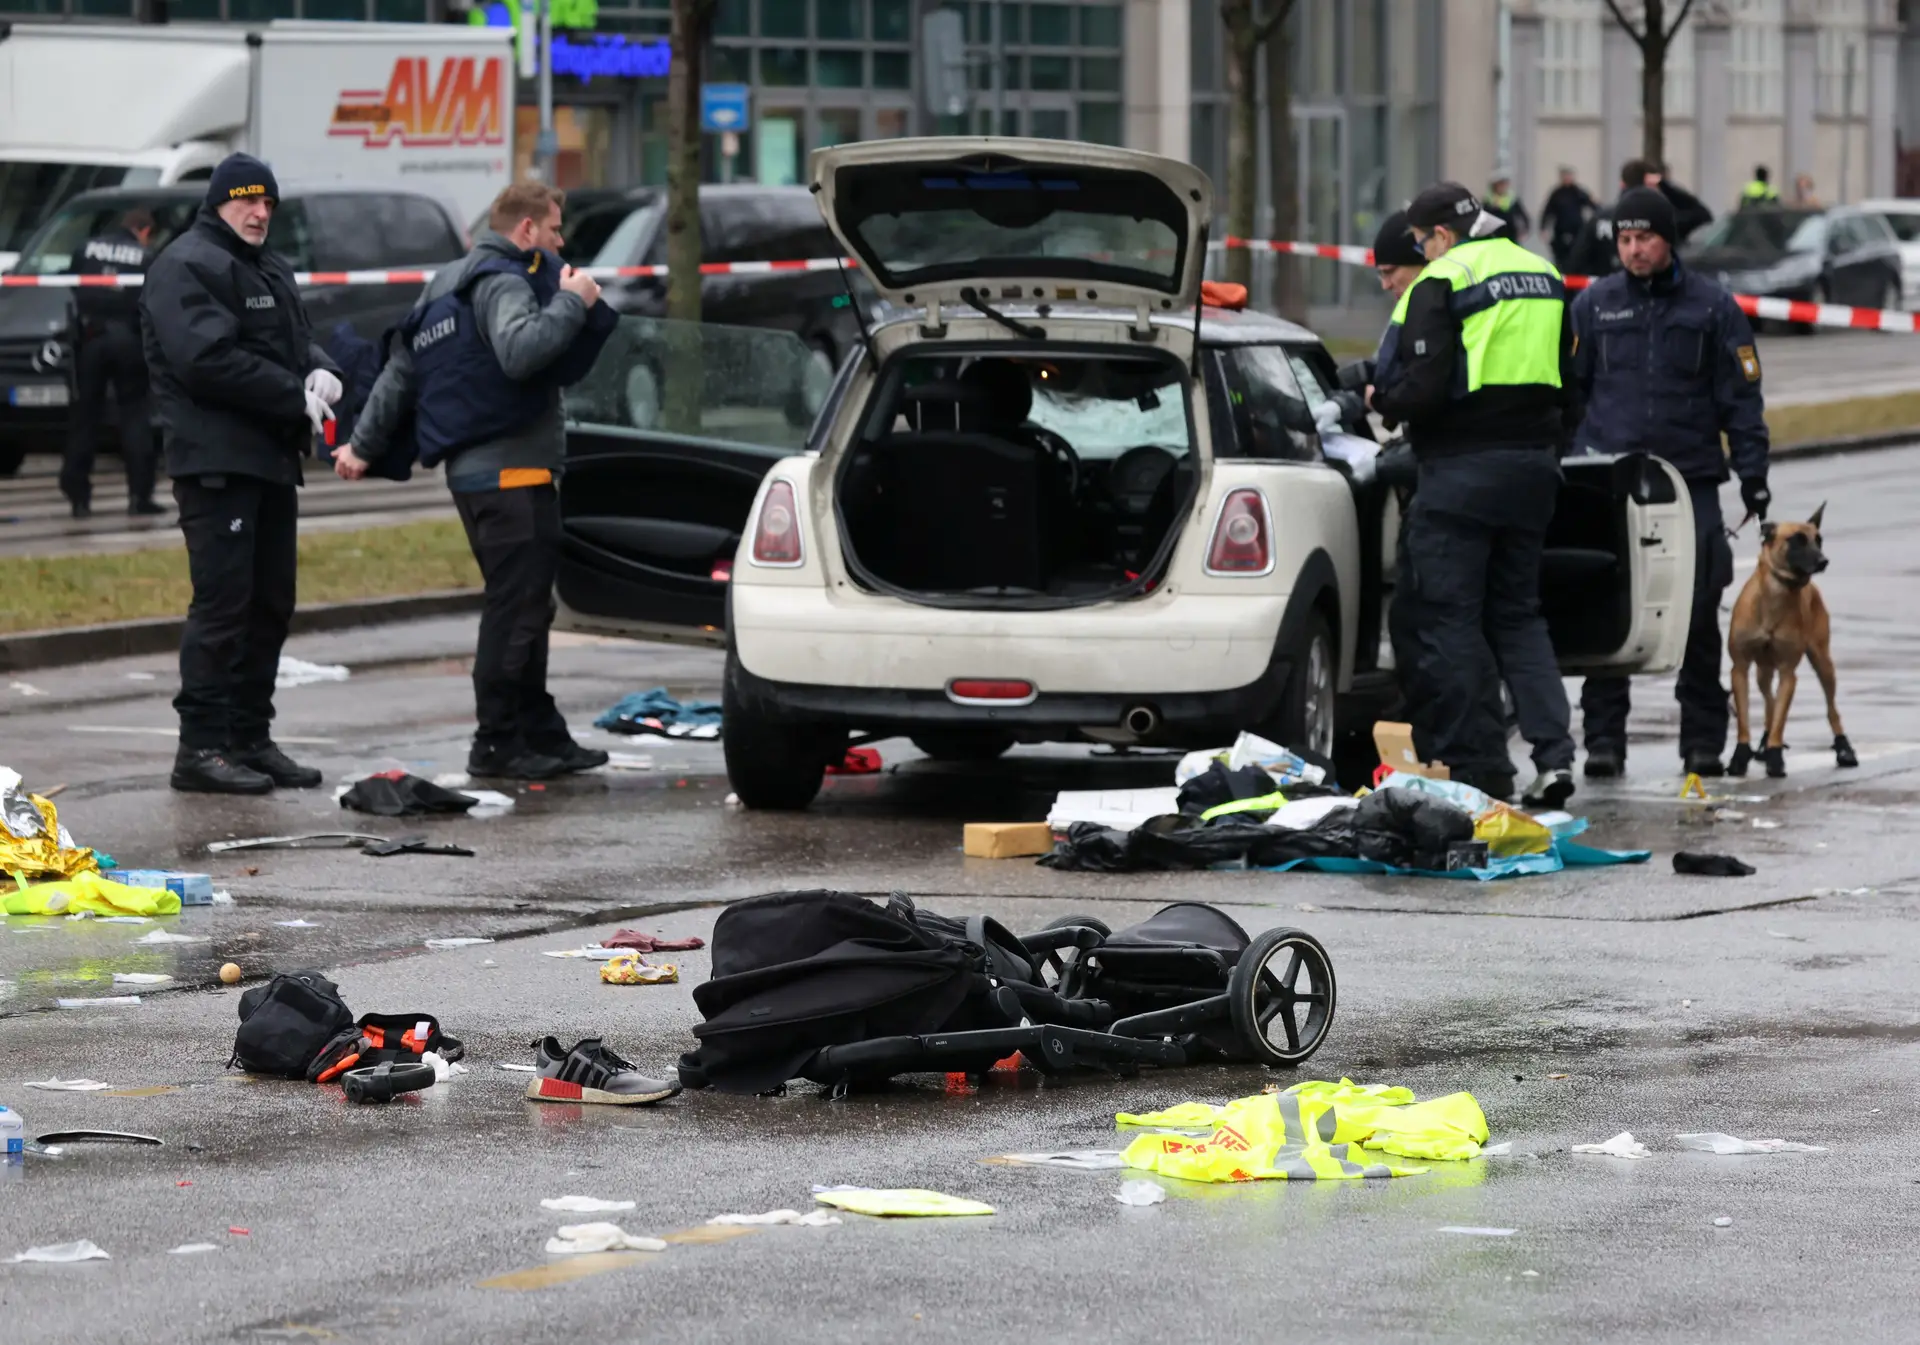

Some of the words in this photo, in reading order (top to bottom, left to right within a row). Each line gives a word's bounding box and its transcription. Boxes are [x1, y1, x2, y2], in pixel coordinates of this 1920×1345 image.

[377, 56, 503, 140] AVM
[229, 184, 265, 199] POLIZEI
[1488, 275, 1552, 300] POLIZEI
[413, 316, 455, 352] POLIZEI
